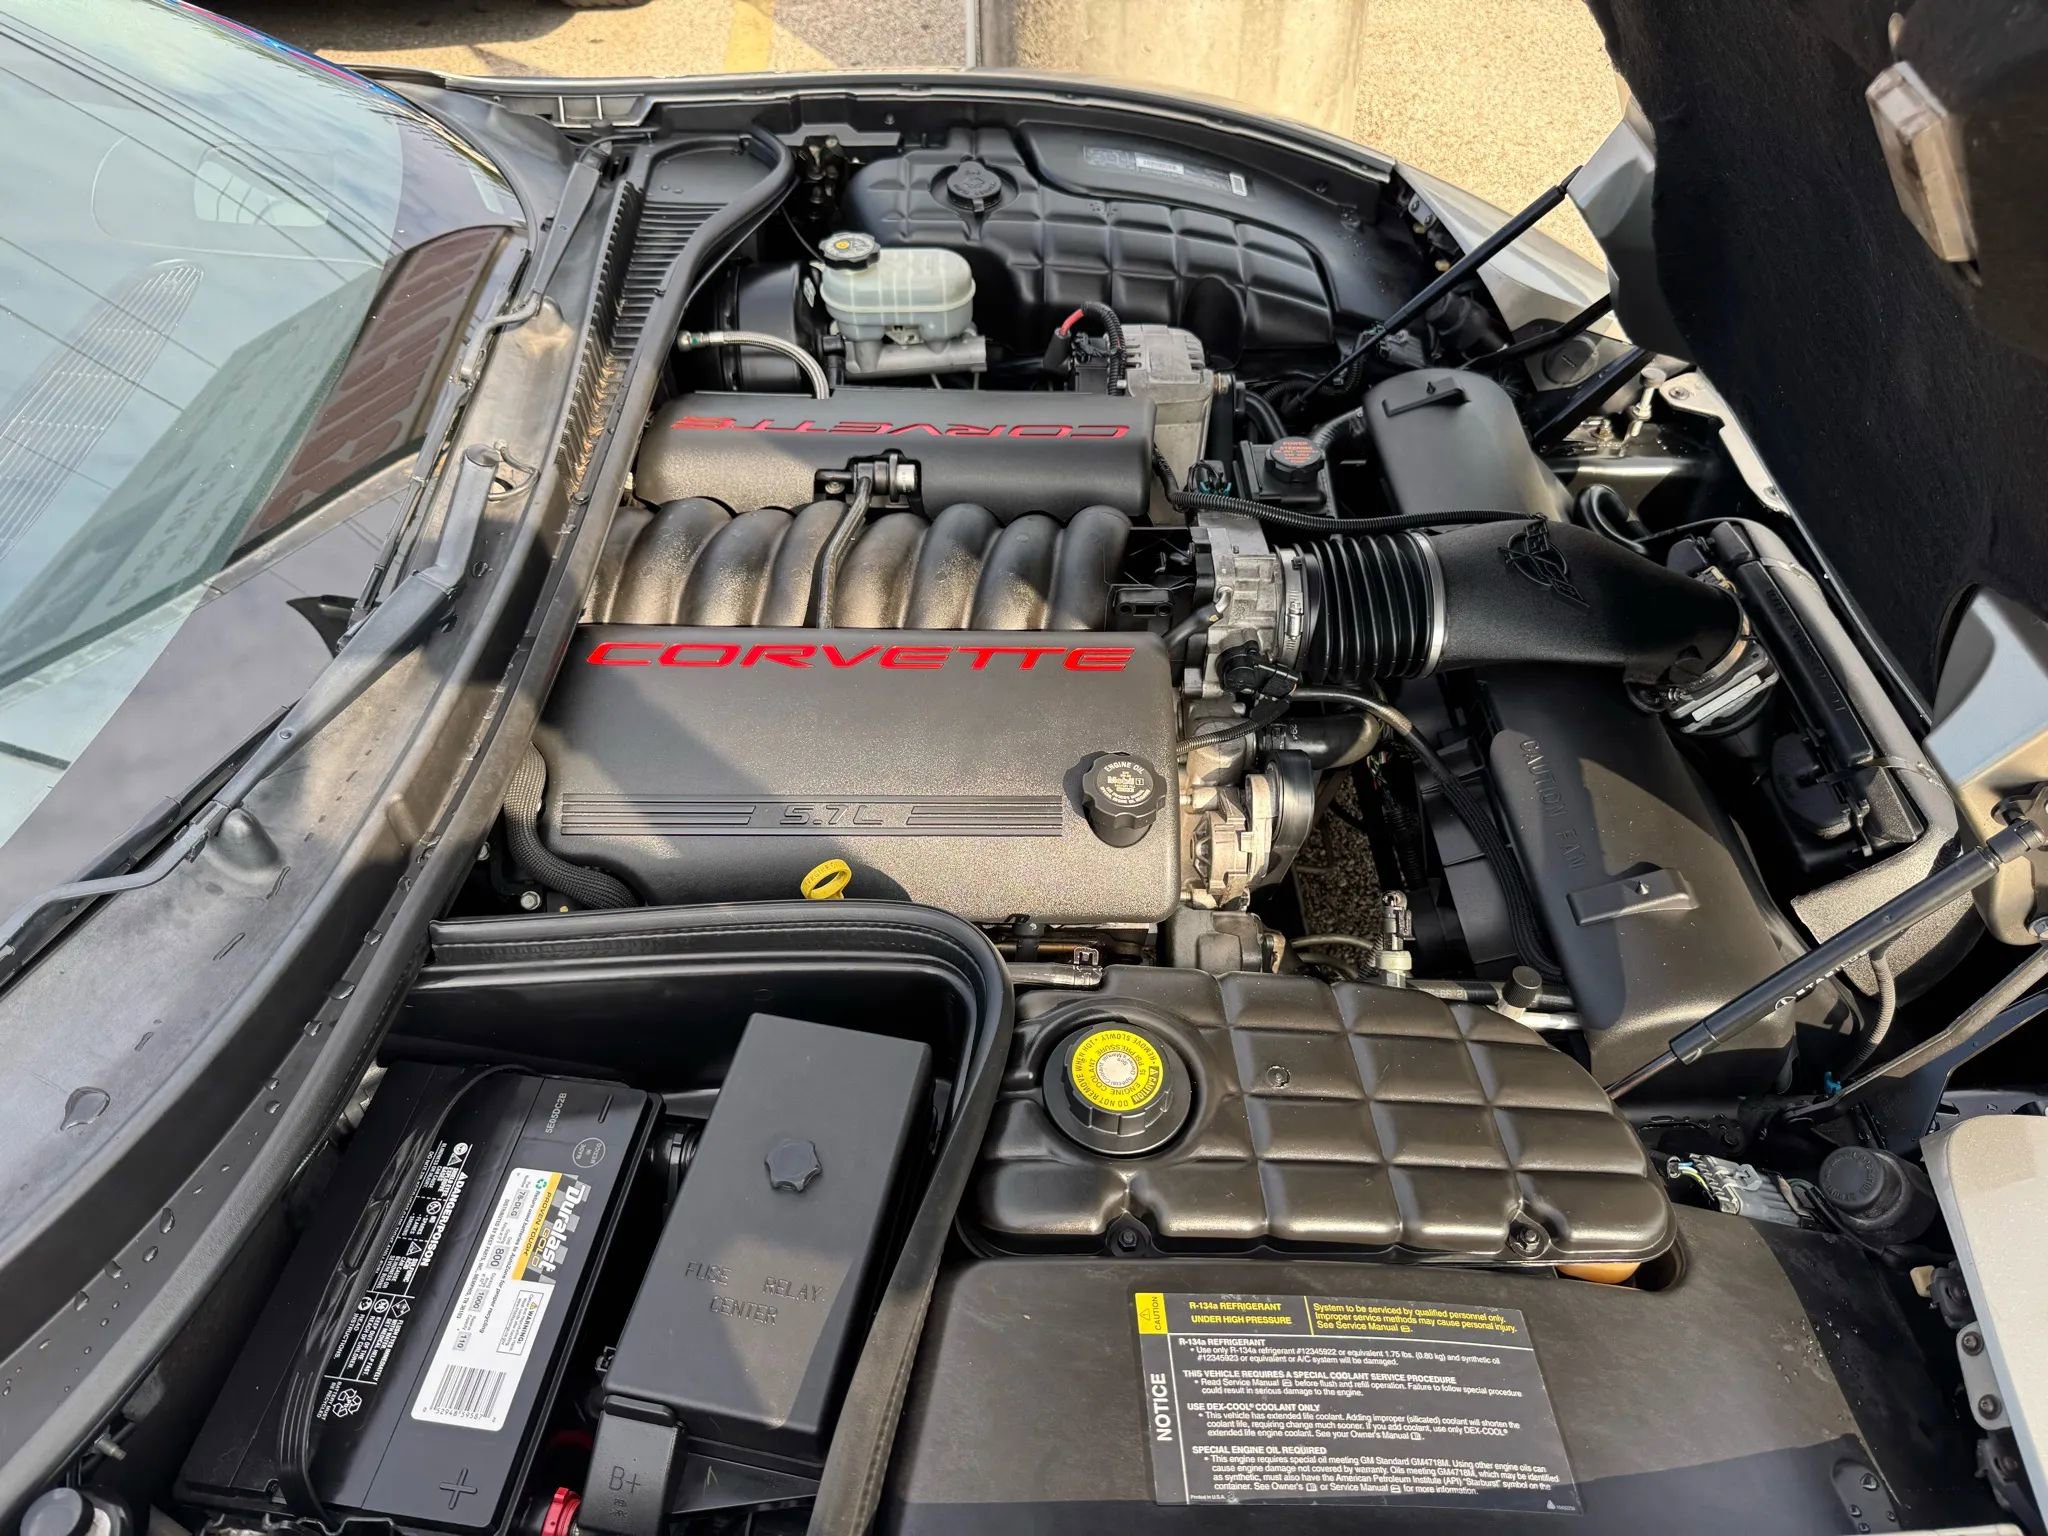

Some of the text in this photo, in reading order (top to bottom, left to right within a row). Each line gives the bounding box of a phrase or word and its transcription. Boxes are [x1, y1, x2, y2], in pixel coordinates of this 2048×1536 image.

[671, 415, 1130, 440] CORVETTE
[586, 641, 1135, 671] CORVETTE
[1104, 761, 1145, 774] ENGINE OIL
[779, 804, 886, 827] 5.7L
[1520, 740, 1587, 871] CAUTION FAN
[1082, 1039, 1094, 1051] HOT
[1096, 1044, 1136, 1056] PRESSURE
[1101, 1033, 1157, 1061] REMOVE SLOWLY
[1074, 1052, 1084, 1071] WHEN
[1135, 1054, 1144, 1066] PSI
[1088, 1057, 1140, 1095] ENGINE COOLANT
[1076, 1073, 1098, 1100] REMOVE
[1132, 1076, 1156, 1102] CAUTION
[1099, 1097, 1115, 1106] NOT
[575, 1142, 586, 1159] MADE
[590, 1142, 602, 1163] MEXICO
[532, 1191, 540, 1208] Return
[419, 1179, 465, 1267] DANGER/POISON
[524, 1192, 551, 1256] PROVEN TOUGH
[540, 1185, 585, 1272] Duralast
[516, 1222, 528, 1245] batteries
[490, 1247, 505, 1267] 800
[532, 1227, 551, 1267] GOLD
[502, 1253, 516, 1279] AutoZone
[498, 1280, 506, 1288] for
[685, 1261, 824, 1303] FUSE RELAY
[473, 1290, 485, 1309] 1000
[489, 1288, 500, 1307] proper
[1219, 1302, 1281, 1310] REFRIGERANT
[710, 1294, 778, 1326] CENTER
[1151, 1296, 1162, 1331] CAUTION
[1222, 1315, 1244, 1323] HIGH
[1245, 1316, 1292, 1324] PRESSURE
[1313, 1303, 1344, 1313] System
[1368, 1305, 1402, 1314] serviced
[1402, 1307, 1413, 1316] by
[1414, 1308, 1448, 1319] qualified
[1448, 1310, 1487, 1322] personnel
[1488, 1314, 1506, 1324] only.
[353, 1314, 365, 1331] READ
[364, 1315, 375, 1333] REACH
[372, 1316, 381, 1329] KEEP
[479, 1307, 494, 1334] recycling
[517, 1310, 534, 1344] WARNING:
[1315, 1312, 1351, 1322] Improper
[1352, 1313, 1382, 1321] service
[1382, 1315, 1417, 1323] methods
[1418, 1318, 1435, 1327] may
[1461, 1320, 1494, 1331] personal
[1494, 1323, 1517, 1334] injury.
[1335, 1321, 1367, 1329] Service
[1367, 1322, 1399, 1331] Manual
[334, 1313, 358, 1359] INSTRUCTIONS.
[366, 1330, 375, 1341] OUT
[375, 1328, 387, 1348] MEDICAL
[380, 1319, 397, 1350] WITH WATER.
[456, 1334, 468, 1349] 110
[347, 1341, 363, 1370] CHILDREN.
[358, 1350, 366, 1360] THE
[369, 1349, 378, 1362] HELP
[373, 1319, 403, 1381] FLUSH EYES IMMEDIATELY
[362, 1362, 372, 1376] FAST.
[1249, 1355, 1287, 1363] equivalent
[1312, 1356, 1338, 1365] system
[1362, 1357, 1398, 1367] damaged.
[1204, 1369, 1239, 1377] VEHICLE
[1329, 1371, 1368, 1379] COOLANT
[1370, 1373, 1405, 1381] SERVICE
[1406, 1374, 1456, 1383] PROCEDURE
[321, 1381, 341, 1420] BATTERY MUST
[1283, 1388, 1313, 1396] damage
[1336, 1389, 1363, 1397] engine.
[317, 1389, 332, 1417] RECYCLED
[1151, 1372, 1173, 1441] NOTICE
[1187, 1402, 1205, 1410] USE
[1255, 1403, 1296, 1411] COOLANT
[1257, 1429, 1283, 1437] engine
[1192, 1445, 1230, 1453] SPECIAL
[1281, 1446, 1327, 1454] REQUIRED
[609, 1465, 641, 1494] B+
[1435, 1486, 1478, 1494] information.
